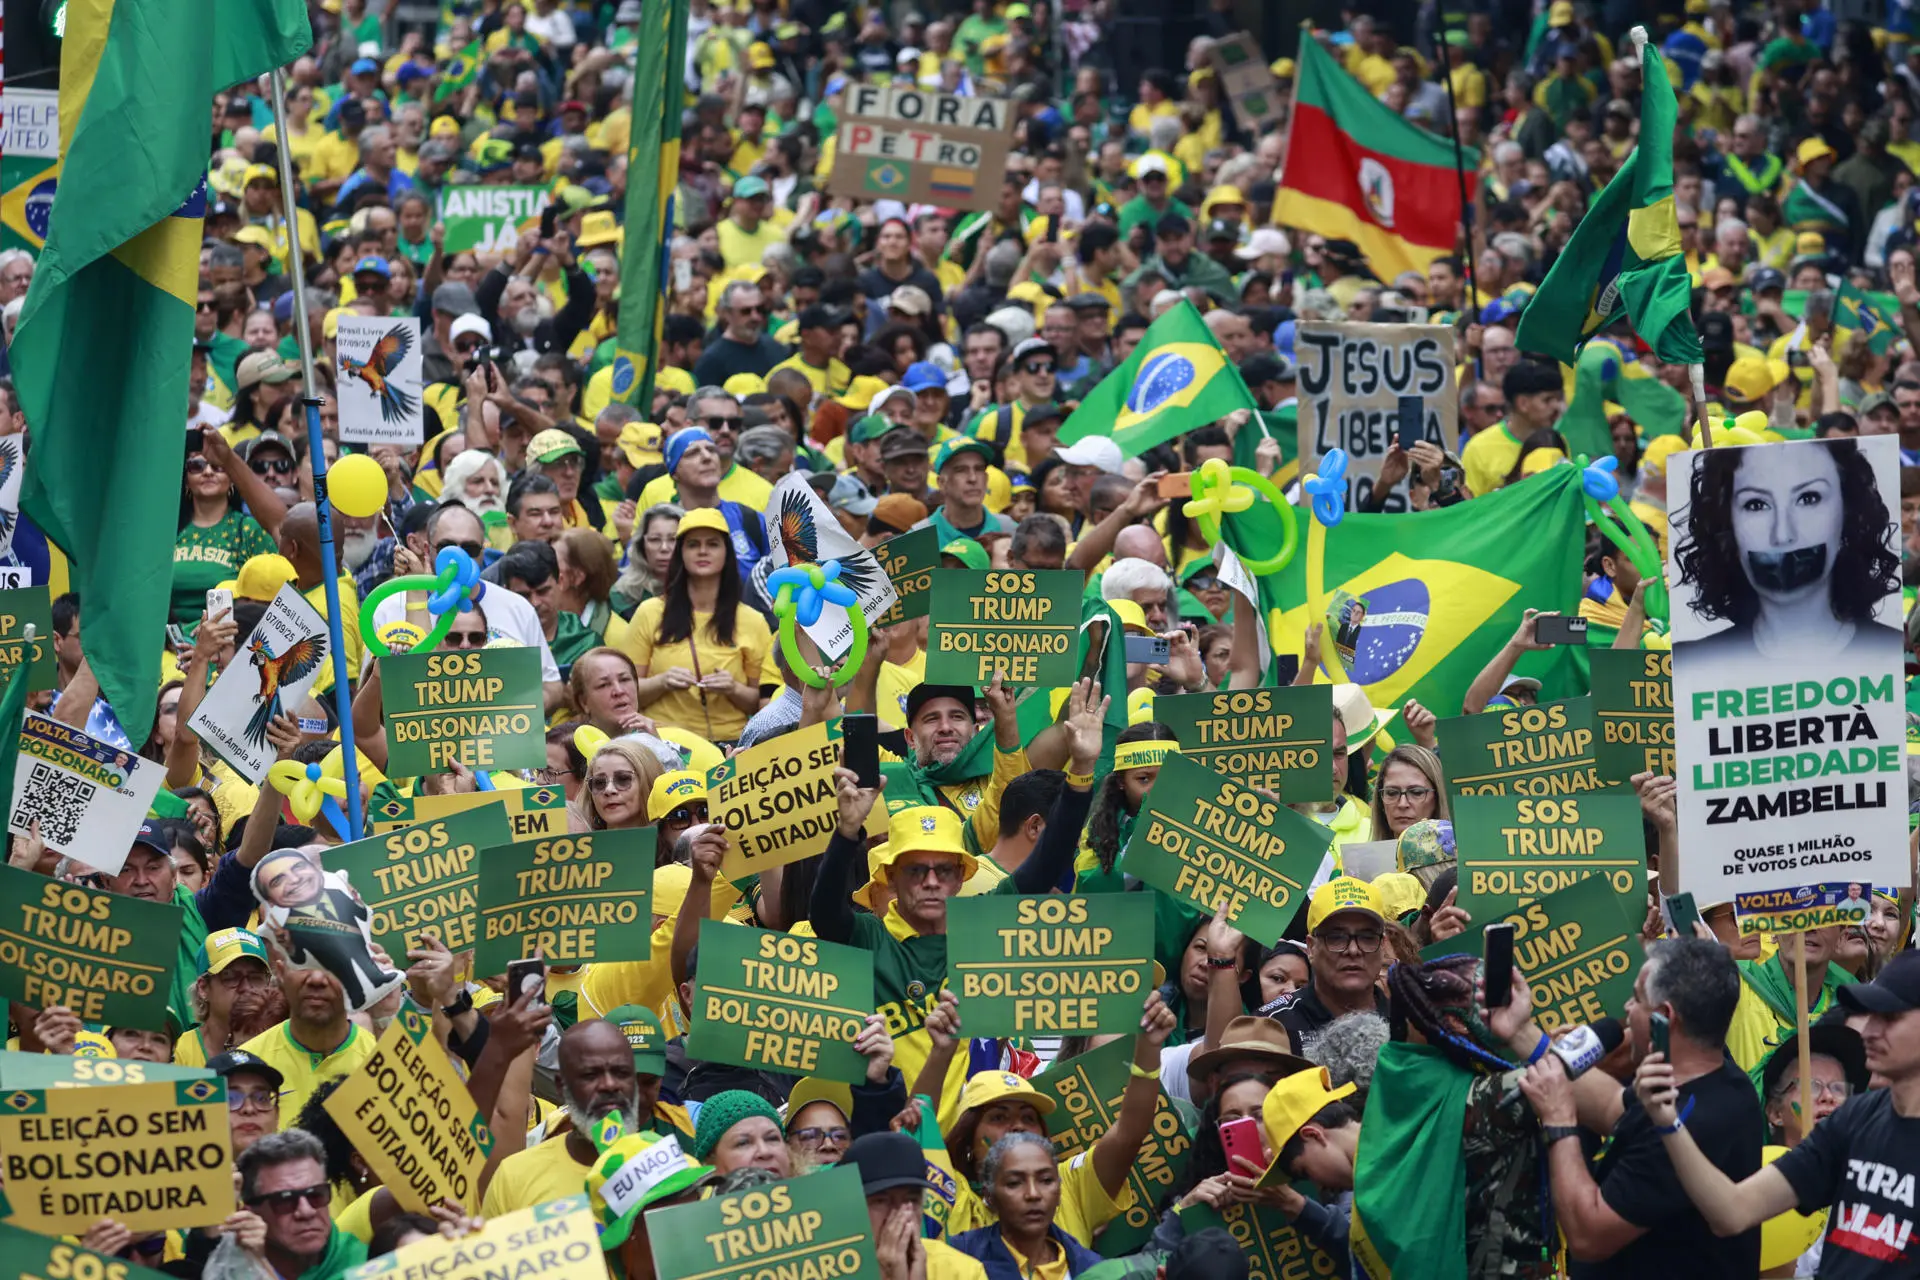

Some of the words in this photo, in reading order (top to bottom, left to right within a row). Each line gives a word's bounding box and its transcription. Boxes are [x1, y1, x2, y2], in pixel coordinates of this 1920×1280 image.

[856, 88, 998, 130] FORA
[444, 189, 550, 217] ANISTIA
[472, 216, 518, 253] JÁ
[337, 326, 361, 335] Brasil
[338, 339, 371, 348] 07/09/25
[1299, 333, 1444, 395] JESUS
[344, 427, 373, 437] Anistia
[374, 428, 402, 438] Ampla
[1315, 399, 1445, 458] LIBERA
[173, 545, 232, 568] RASIL
[984, 572, 1036, 594] SOS
[273, 596, 296, 621] Brasil
[294, 617, 313, 637] Livre
[969, 596, 1052, 621] TRUMP
[264, 612, 295, 643] 07/09/25
[827, 620, 853, 649] Anisti
[939, 631, 1069, 654] BOLSONARO
[427, 653, 482, 677] SOS
[977, 655, 1039, 682] FREE
[414, 677, 504, 706] TRUMP
[1212, 691, 1272, 716] SOS
[1629, 681, 1674, 708] TRU
[1692, 674, 1894, 721] FREEDOM
[27, 718, 71, 742] VOLTA
[395, 713, 531, 743] BOLSONARO
[1195, 714, 1293, 744] TRUMP
[1502, 705, 1568, 736] SOS
[1604, 720, 1675, 744] BOLSO
[1708, 704, 1879, 756] LIBERTÀ
[199, 714, 226, 741] Anistia
[224, 736, 249, 762] Ampla
[248, 756, 261, 771] Já
[428, 738, 495, 769] FREE
[1486, 728, 1593, 768] TRUMP
[19, 737, 122, 788] BOLSONARO
[720, 756, 802, 804] ELEIÇÃO
[1645, 748, 1676, 776] FR
[1693, 745, 1901, 791] LIBERDADE
[712, 774, 840, 832] OLSONA
[1216, 783, 1278, 827] SOS
[1517, 799, 1580, 824] SOS
[1706, 781, 1887, 825] ZAMBELLI
[386, 822, 449, 860] SOS
[509, 812, 550, 835] EM
[738, 835, 755, 859] É
[755, 809, 840, 854] DITADU
[1192, 797, 1286, 862] TRUMP
[533, 836, 593, 865] SOS
[1501, 828, 1604, 856] TRUMP
[1733, 844, 1785, 861] QUASE
[1788, 843, 1794, 854] 1
[1797, 834, 1855, 854] MILHÃO
[373, 844, 475, 895] TRUMP
[516, 861, 613, 897] TRUMP
[1146, 821, 1291, 909] BOLSONARO
[1722, 864, 1744, 875] DE
[1748, 857, 1798, 874] VOTOS
[1800, 850, 1873, 866] CALADOS
[1174, 864, 1249, 922] FREE
[1471, 870, 1634, 895] BOLSONO
[1738, 891, 1793, 909] VOLTA
[41, 883, 112, 920] SOS
[370, 885, 479, 936] OLSONA
[1017, 898, 1089, 925] SOS
[20, 904, 132, 955] TRUMP
[486, 900, 638, 940] BOLSONARO
[1742, 907, 1866, 934] BOLSONARO
[521, 928, 596, 960] FREE
[759, 933, 819, 966] SOS
[997, 927, 1113, 958] TRUMP
[1513, 922, 1582, 971] UMP
[0, 940, 155, 996] OLSONARO
[741, 958, 839, 1000] TRUMP
[963, 969, 1141, 998] BOLSONARO
[1531, 949, 1630, 1008] ONARO
[24, 974, 106, 1020] FREE
[1014, 998, 1099, 1031] FREE
[1532, 990, 1607, 1035] REE
[705, 996, 863, 1043] BOLSONARO
[744, 1030, 821, 1072] FREE
[73, 1059, 146, 1085] SOS
[355, 1096, 379, 1121] É
[393, 1035, 451, 1121] ELEIÇÃO
[448, 1117, 476, 1165] SEM
[19, 1108, 138, 1147] ELEIÇÃO
[147, 1109, 207, 1135] SEM
[364, 1051, 468, 1200] BOLSONARO
[7, 1144, 224, 1181] BOLSONARO
[366, 1114, 446, 1209] DITADURA
[612, 1174, 634, 1201] EU
[634, 1150, 669, 1181] NÃO
[39, 1187, 55, 1216] É
[62, 1185, 207, 1216] DITADURA
[720, 1185, 793, 1226] SOS
[507, 1220, 569, 1252] SEM
[705, 1210, 822, 1263] TRUMP
